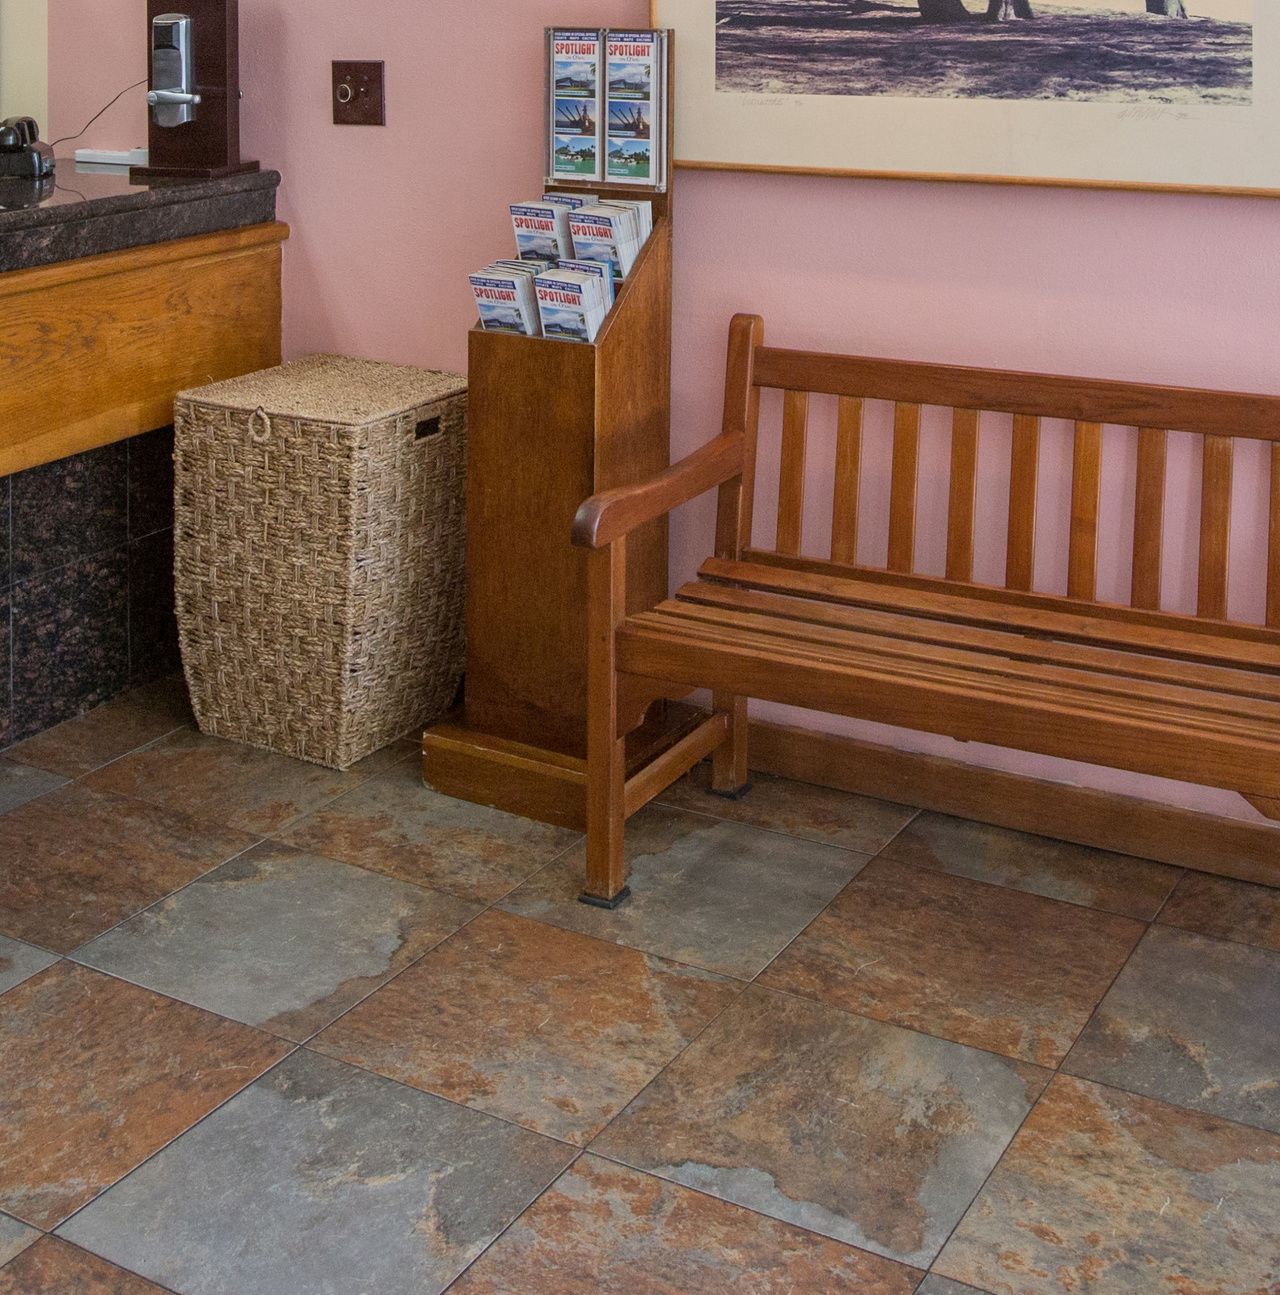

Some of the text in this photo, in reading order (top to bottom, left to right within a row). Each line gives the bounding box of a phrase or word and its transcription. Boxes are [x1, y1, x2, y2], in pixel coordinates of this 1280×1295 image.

[555, 43, 596, 55] SPOTLIGHT
[608, 44, 651, 57] SPOTLIGHT
[514, 217, 554, 231] SPOTLIGHT
[571, 224, 613, 239] SPOTLIGHT
[473, 287, 516, 301] SPOTLIGHT
[538, 289, 581, 306] SPOTLIGHT
